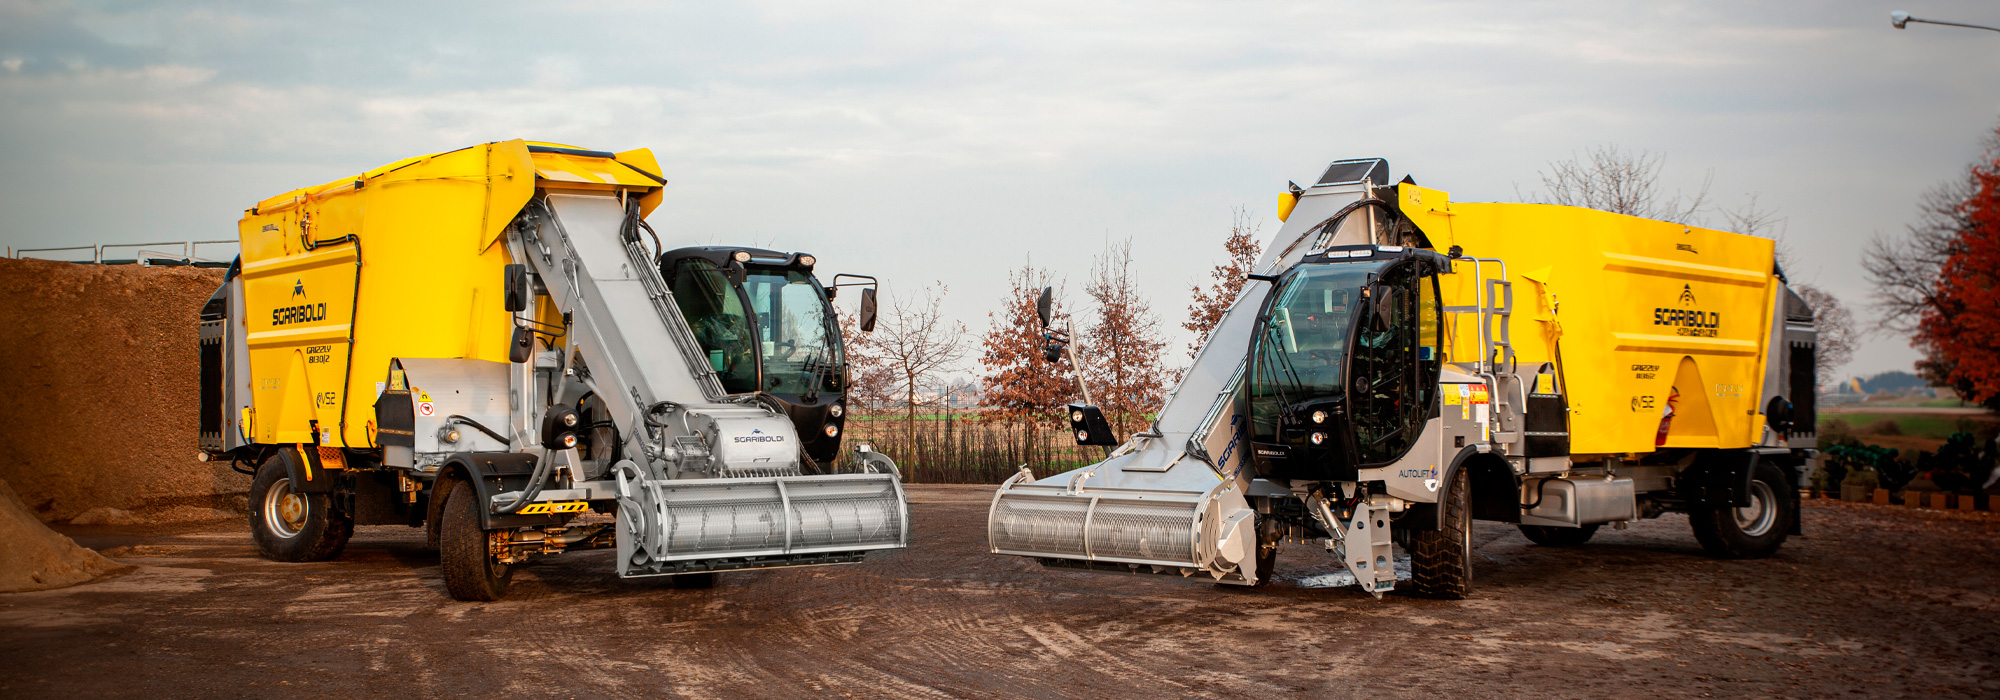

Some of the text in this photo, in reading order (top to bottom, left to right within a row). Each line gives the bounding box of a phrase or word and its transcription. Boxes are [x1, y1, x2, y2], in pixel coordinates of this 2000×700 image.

[272, 302, 327, 326] SGARIBOLDI
[1654, 308, 1720, 328] SGARIBOLDI
[306, 345, 332, 354] GRIZZLY
[734, 435, 784, 443] SGARIBOLDI
[1399, 469, 1430, 478] AUTOLIFT
